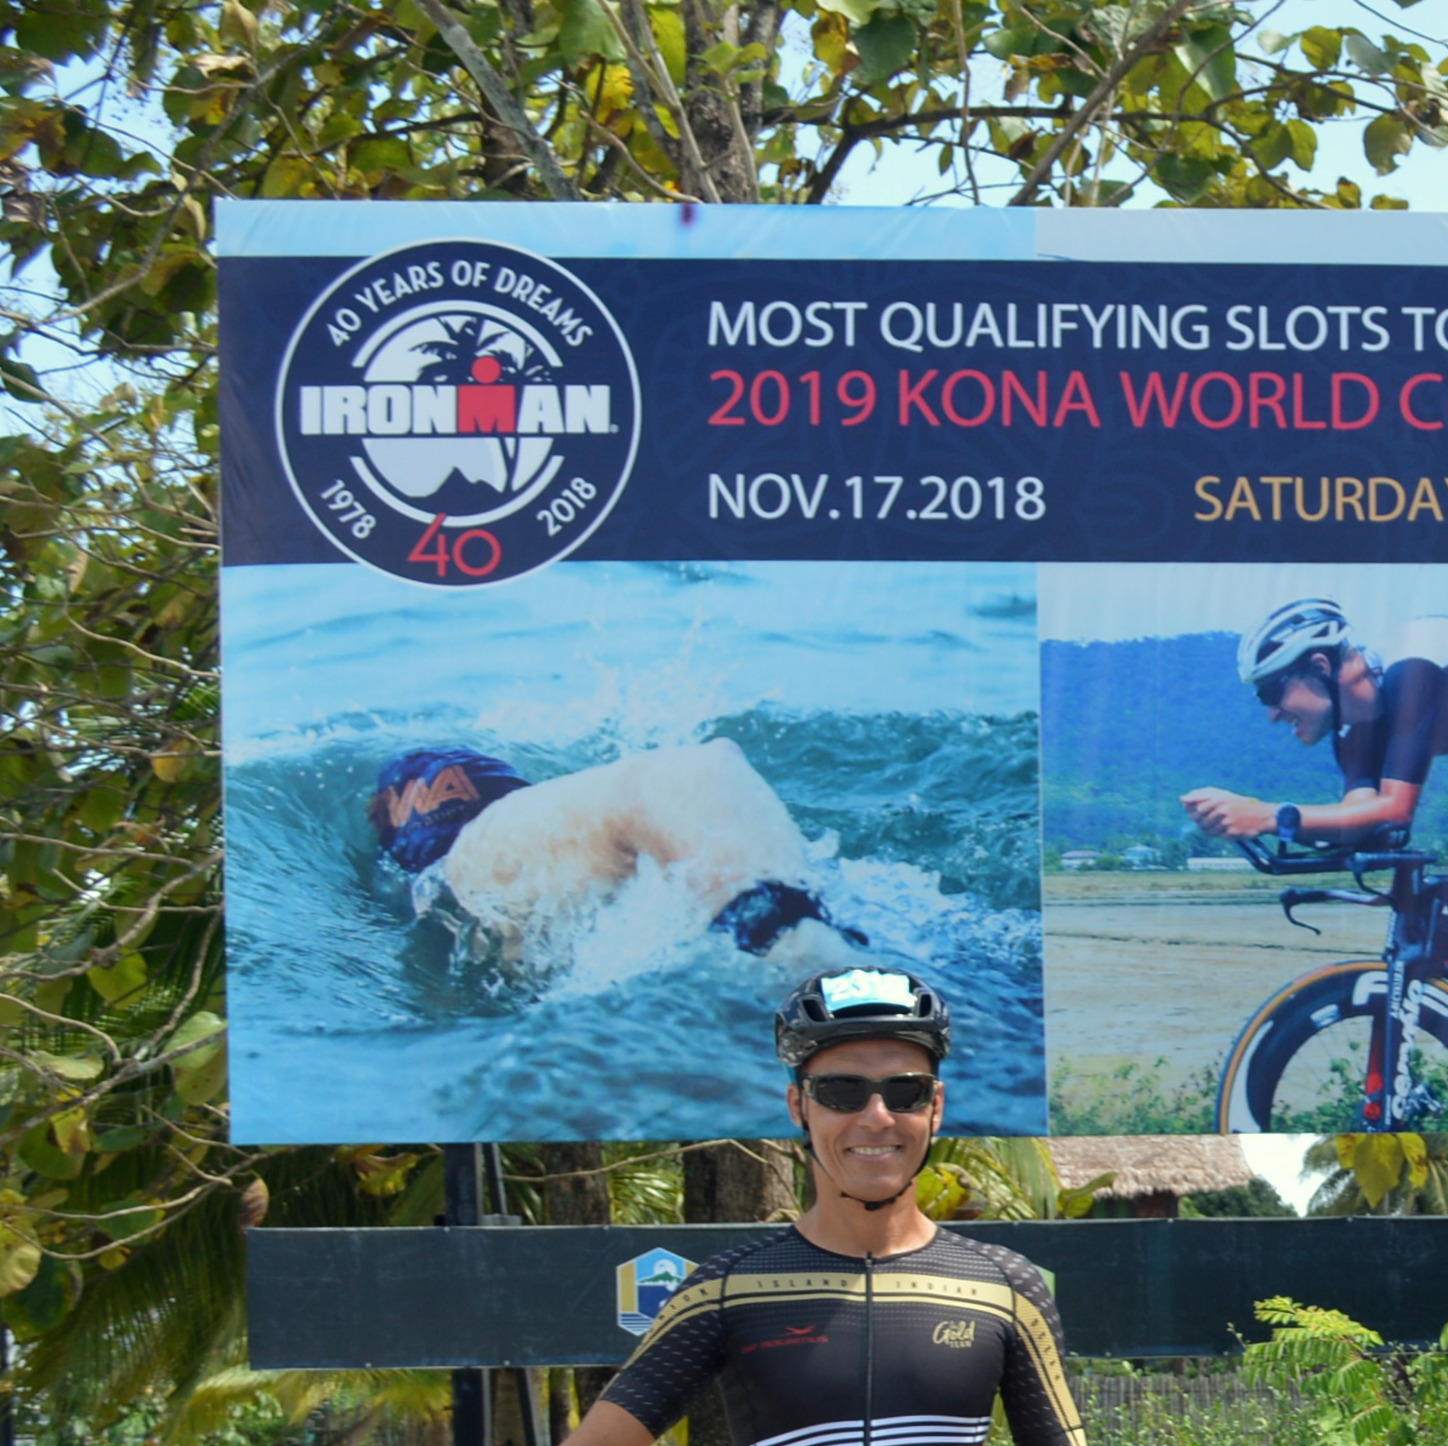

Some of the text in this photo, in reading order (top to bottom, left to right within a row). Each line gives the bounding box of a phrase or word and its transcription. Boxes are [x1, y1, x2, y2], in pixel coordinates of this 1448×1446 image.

[326, 260, 593, 347] 40 YEARS OF DREAMS
[708, 301, 868, 347] MOST
[880, 301, 1210, 352] QUALIFYING
[1226, 304, 1390, 351] SLOTS
[300, 382, 610, 435] IRONMAN
[708, 369, 877, 427] 2019
[899, 369, 1101, 427] KONA
[1120, 371, 1380, 429] WORLD
[320, 479, 376, 539] 1978
[537, 477, 597, 537] 2018
[708, 473, 1046, 520] NOV.17.2018
[407, 513, 501, 577] 40
[757, 1279, 848, 1289] ISLAND
[932, 1321, 975, 1345] Gold
